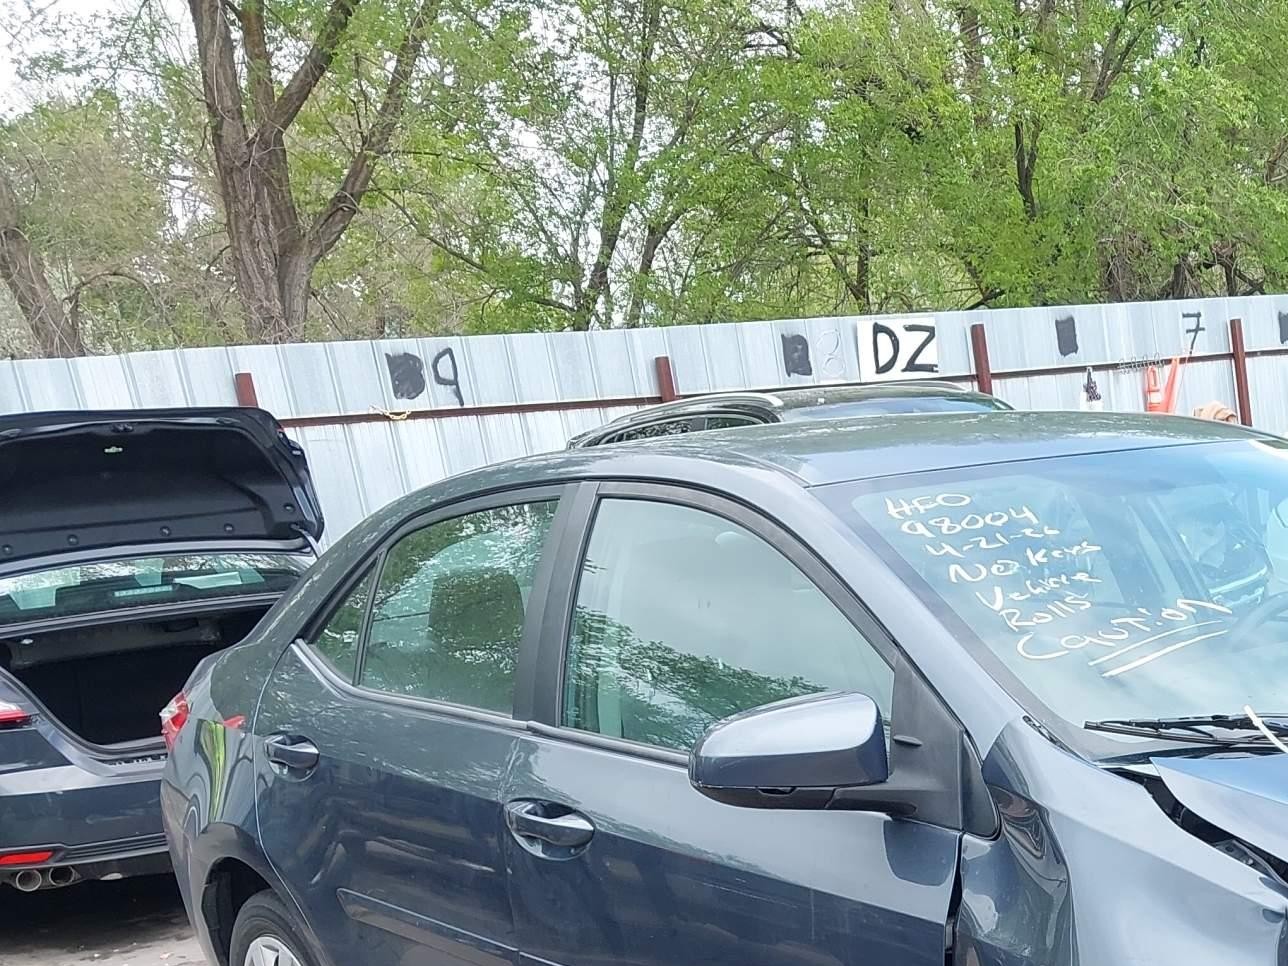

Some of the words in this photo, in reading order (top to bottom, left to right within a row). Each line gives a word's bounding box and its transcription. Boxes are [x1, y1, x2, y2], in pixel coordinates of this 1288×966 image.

[1182, 312, 1205, 355] 7
[432, 347, 464, 407] 9
[902, 505, 1039, 538] 98004
